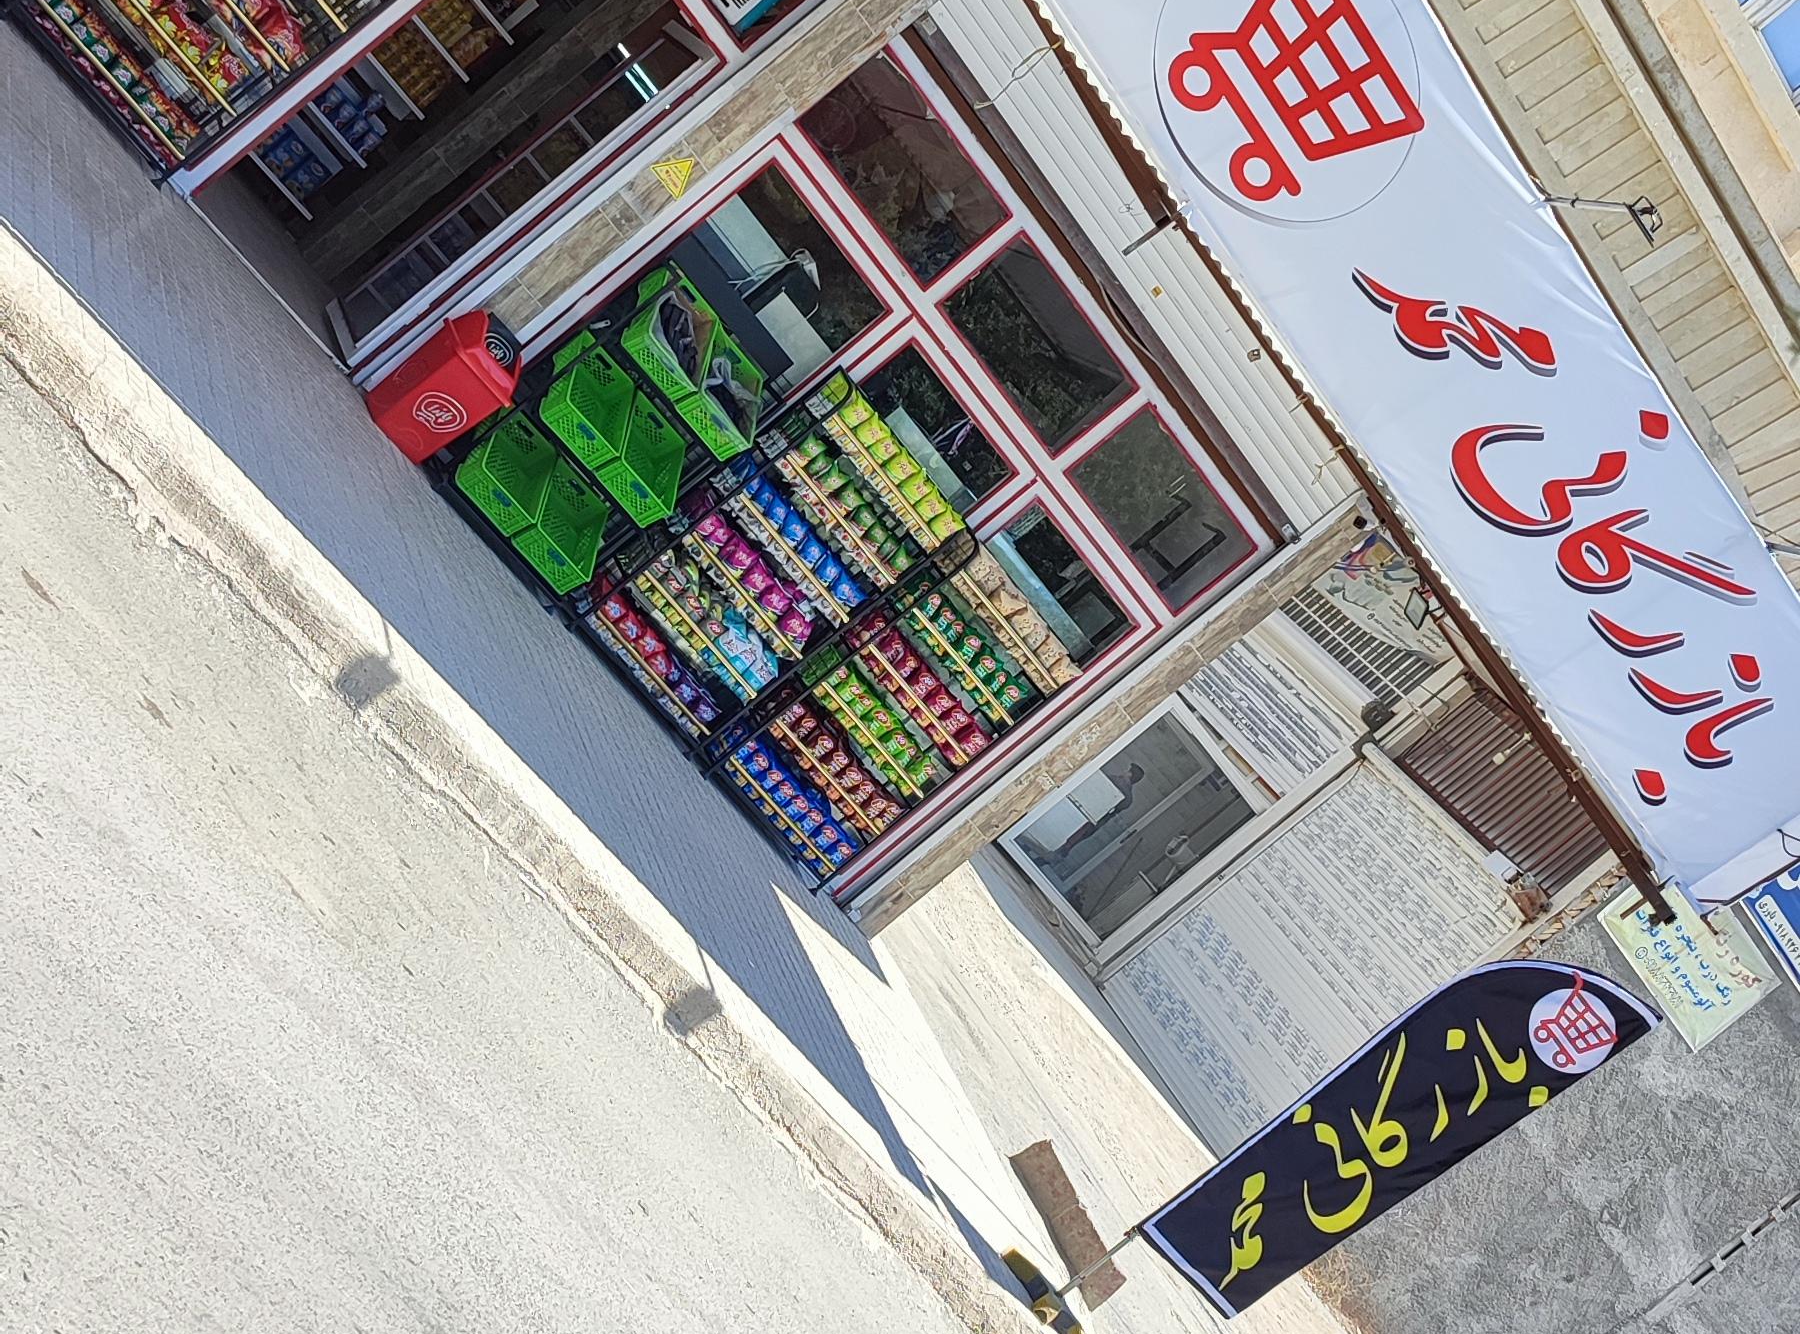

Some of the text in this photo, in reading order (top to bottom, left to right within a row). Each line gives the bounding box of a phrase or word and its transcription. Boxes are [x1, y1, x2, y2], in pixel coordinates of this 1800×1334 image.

[1351, 267, 1776, 806] بازرگانی محمد
[1218, 1170, 1268, 1292] محمد
[1291, 1016, 1551, 1234] بازرگانی
